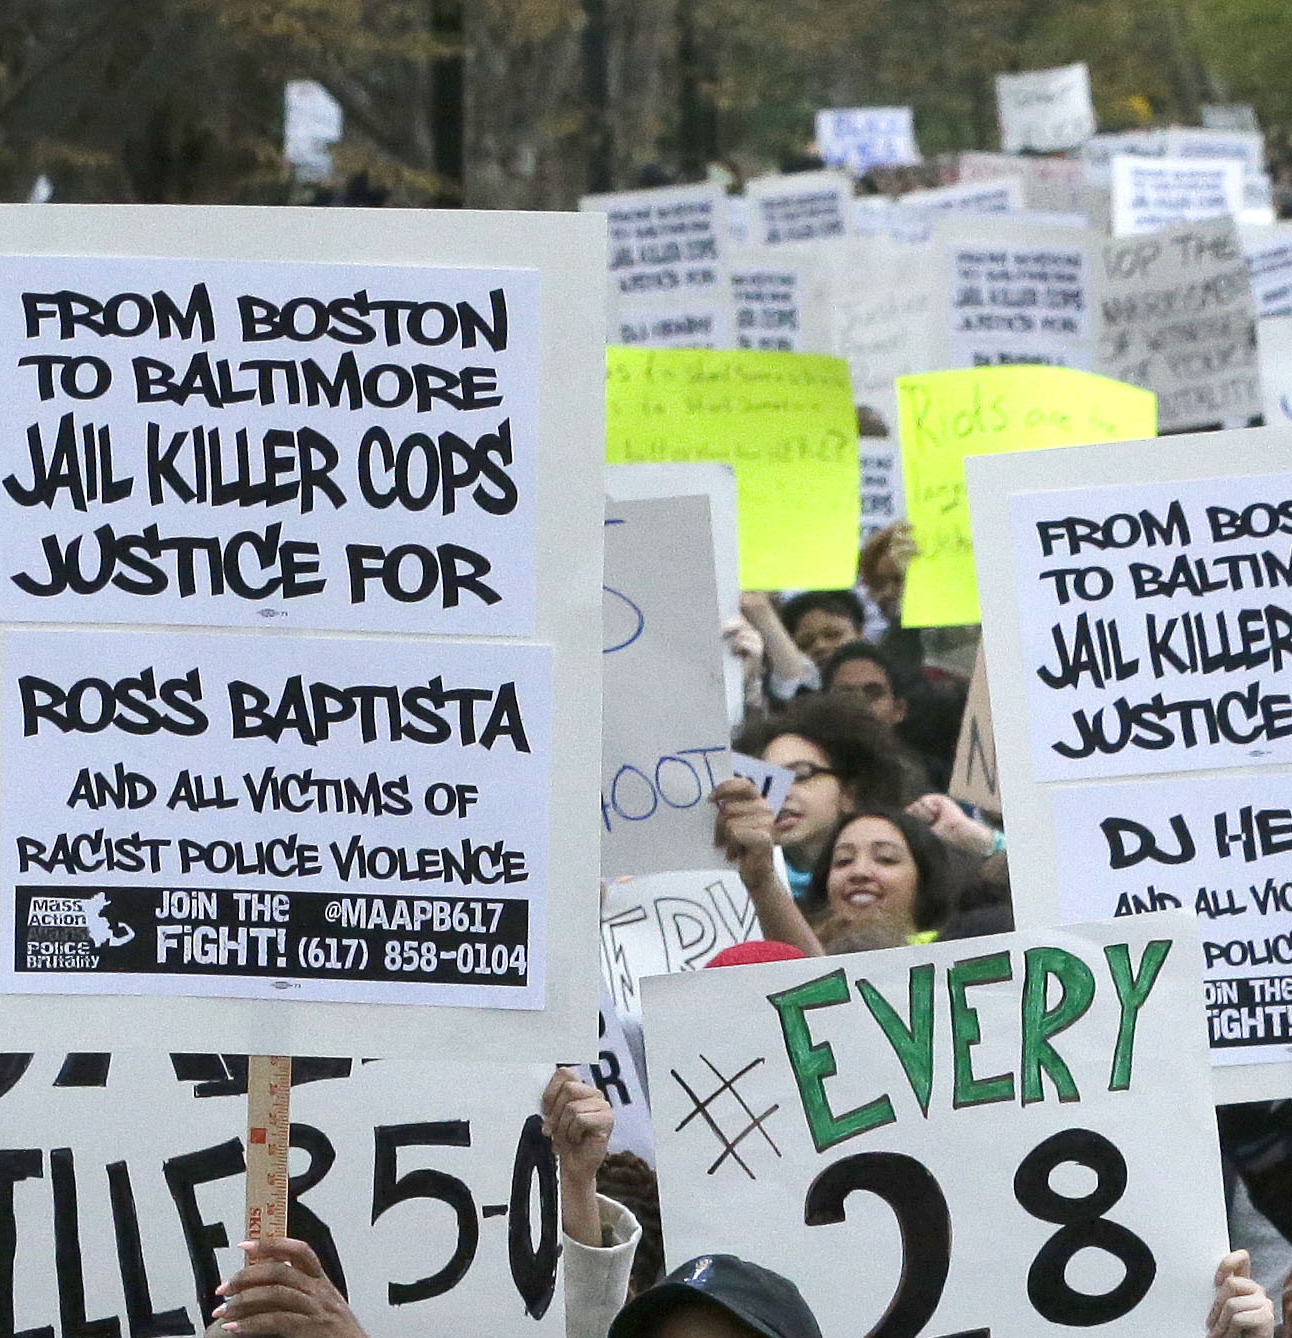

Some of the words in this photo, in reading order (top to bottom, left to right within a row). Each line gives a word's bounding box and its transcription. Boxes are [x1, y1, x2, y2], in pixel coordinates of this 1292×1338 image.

[21, 282, 216, 344] FROM
[236, 287, 508, 353] BOSTON
[17, 354, 112, 402] TO
[131, 347, 506, 414] BALTIMORE
[1, 411, 135, 513] JAIL
[146, 421, 348, 515] KILLER
[357, 416, 518, 517] COPS
[1035, 499, 1192, 560] FROM
[10, 521, 328, 600] JUSTICE
[345, 542, 503, 609] FOR
[1039, 566, 1114, 605] TO
[1036, 611, 1140, 690] JAIL
[17, 665, 209, 738] ROSS
[227, 674, 531, 754] BAPTISTA
[66, 761, 157, 811] AND
[166, 769, 240, 813] ALL
[242, 766, 414, 818] VICTIMS
[424, 782, 479, 819] OF
[15, 827, 172, 875] RACIST
[178, 832, 323, 878] POLICE
[328, 834, 530, 886] VIOLENCE
[1099, 813, 1196, 870] DJ
[324, 898, 505, 934] @MAAPB617
[1194, 886, 1248, 920] ALL
[298, 936, 369, 970] (617)
[384, 940, 529, 979] 858-0104
